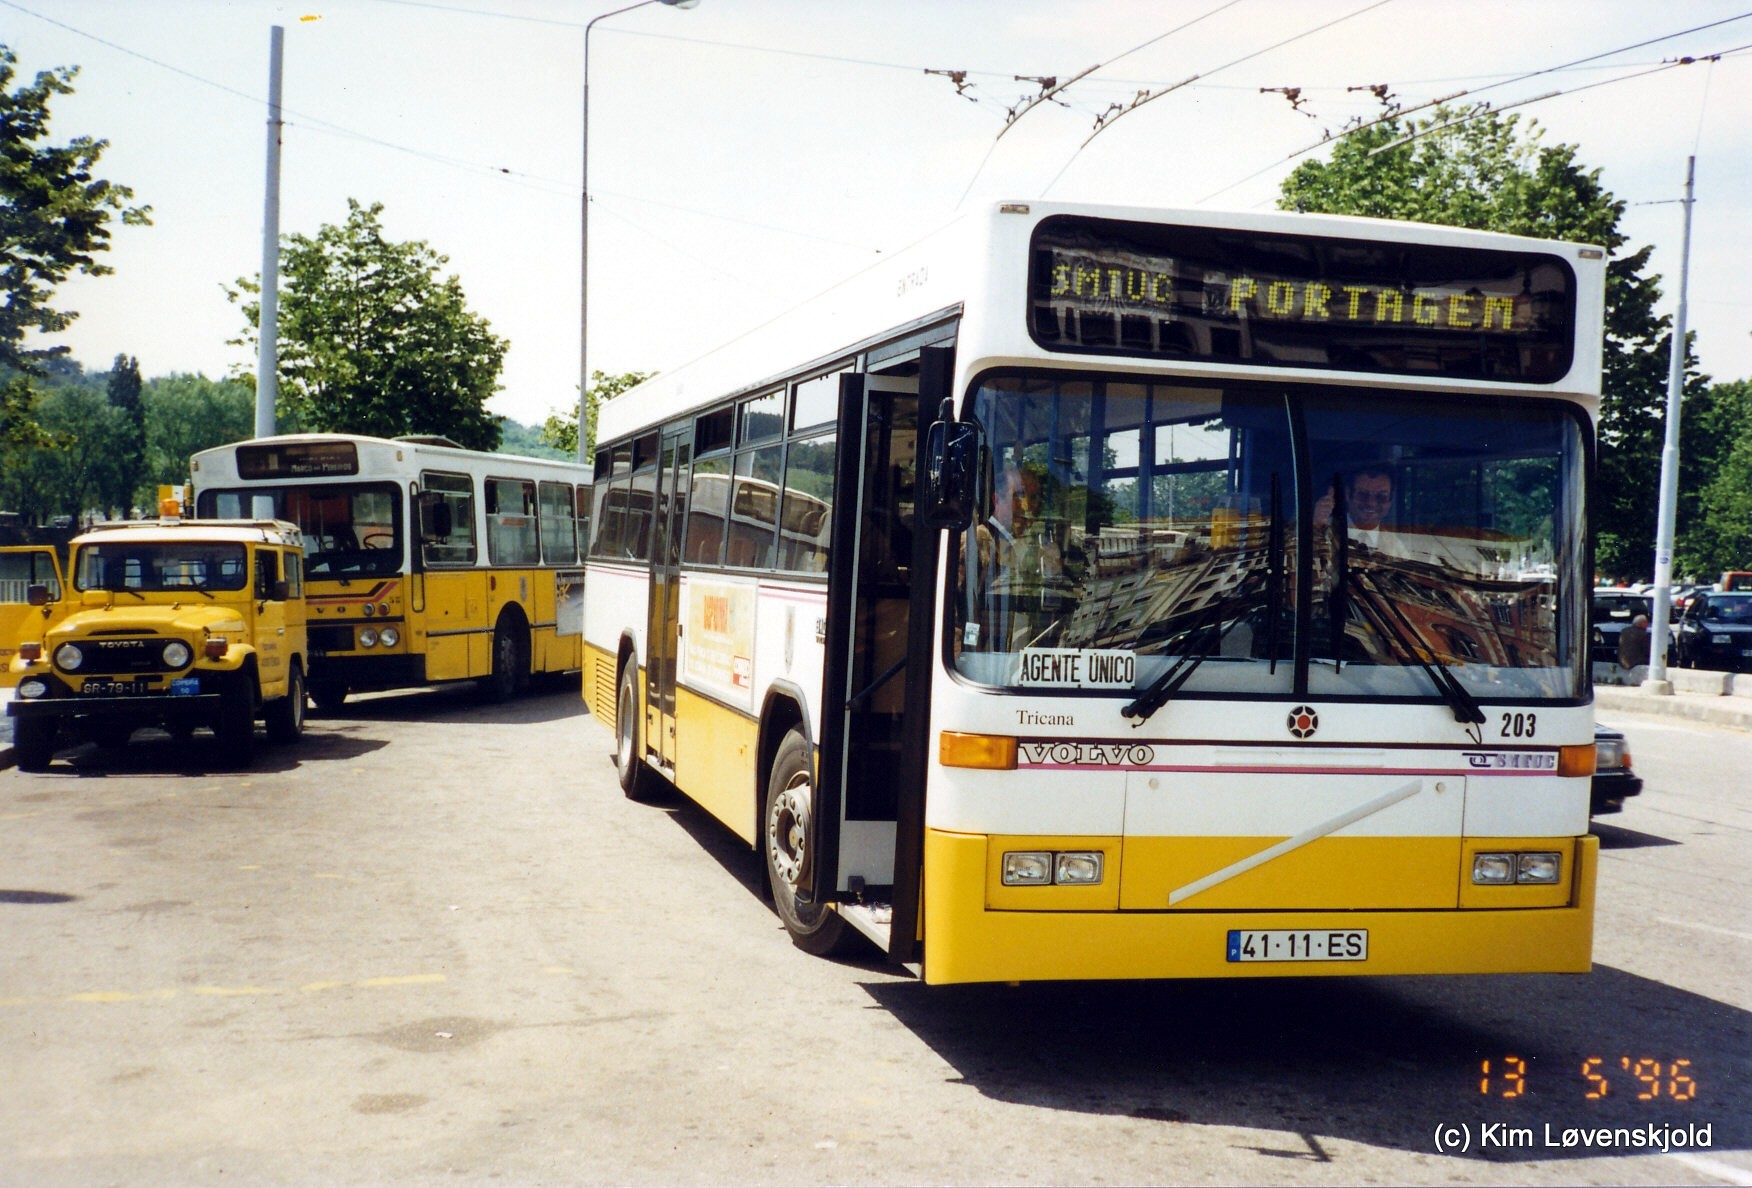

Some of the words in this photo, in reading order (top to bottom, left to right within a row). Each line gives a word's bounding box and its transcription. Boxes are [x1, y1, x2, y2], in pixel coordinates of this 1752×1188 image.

[1051, 265, 1171, 301] SMTUC
[1231, 278, 1513, 330] PORTAGEM
[1020, 653, 1081, 683] AGENTE
[1089, 652, 1135, 683] ÚNICO
[1016, 710, 1074, 726] Tricana
[1501, 713, 1536, 738] 203
[1020, 743, 1154, 765] VOLVO
